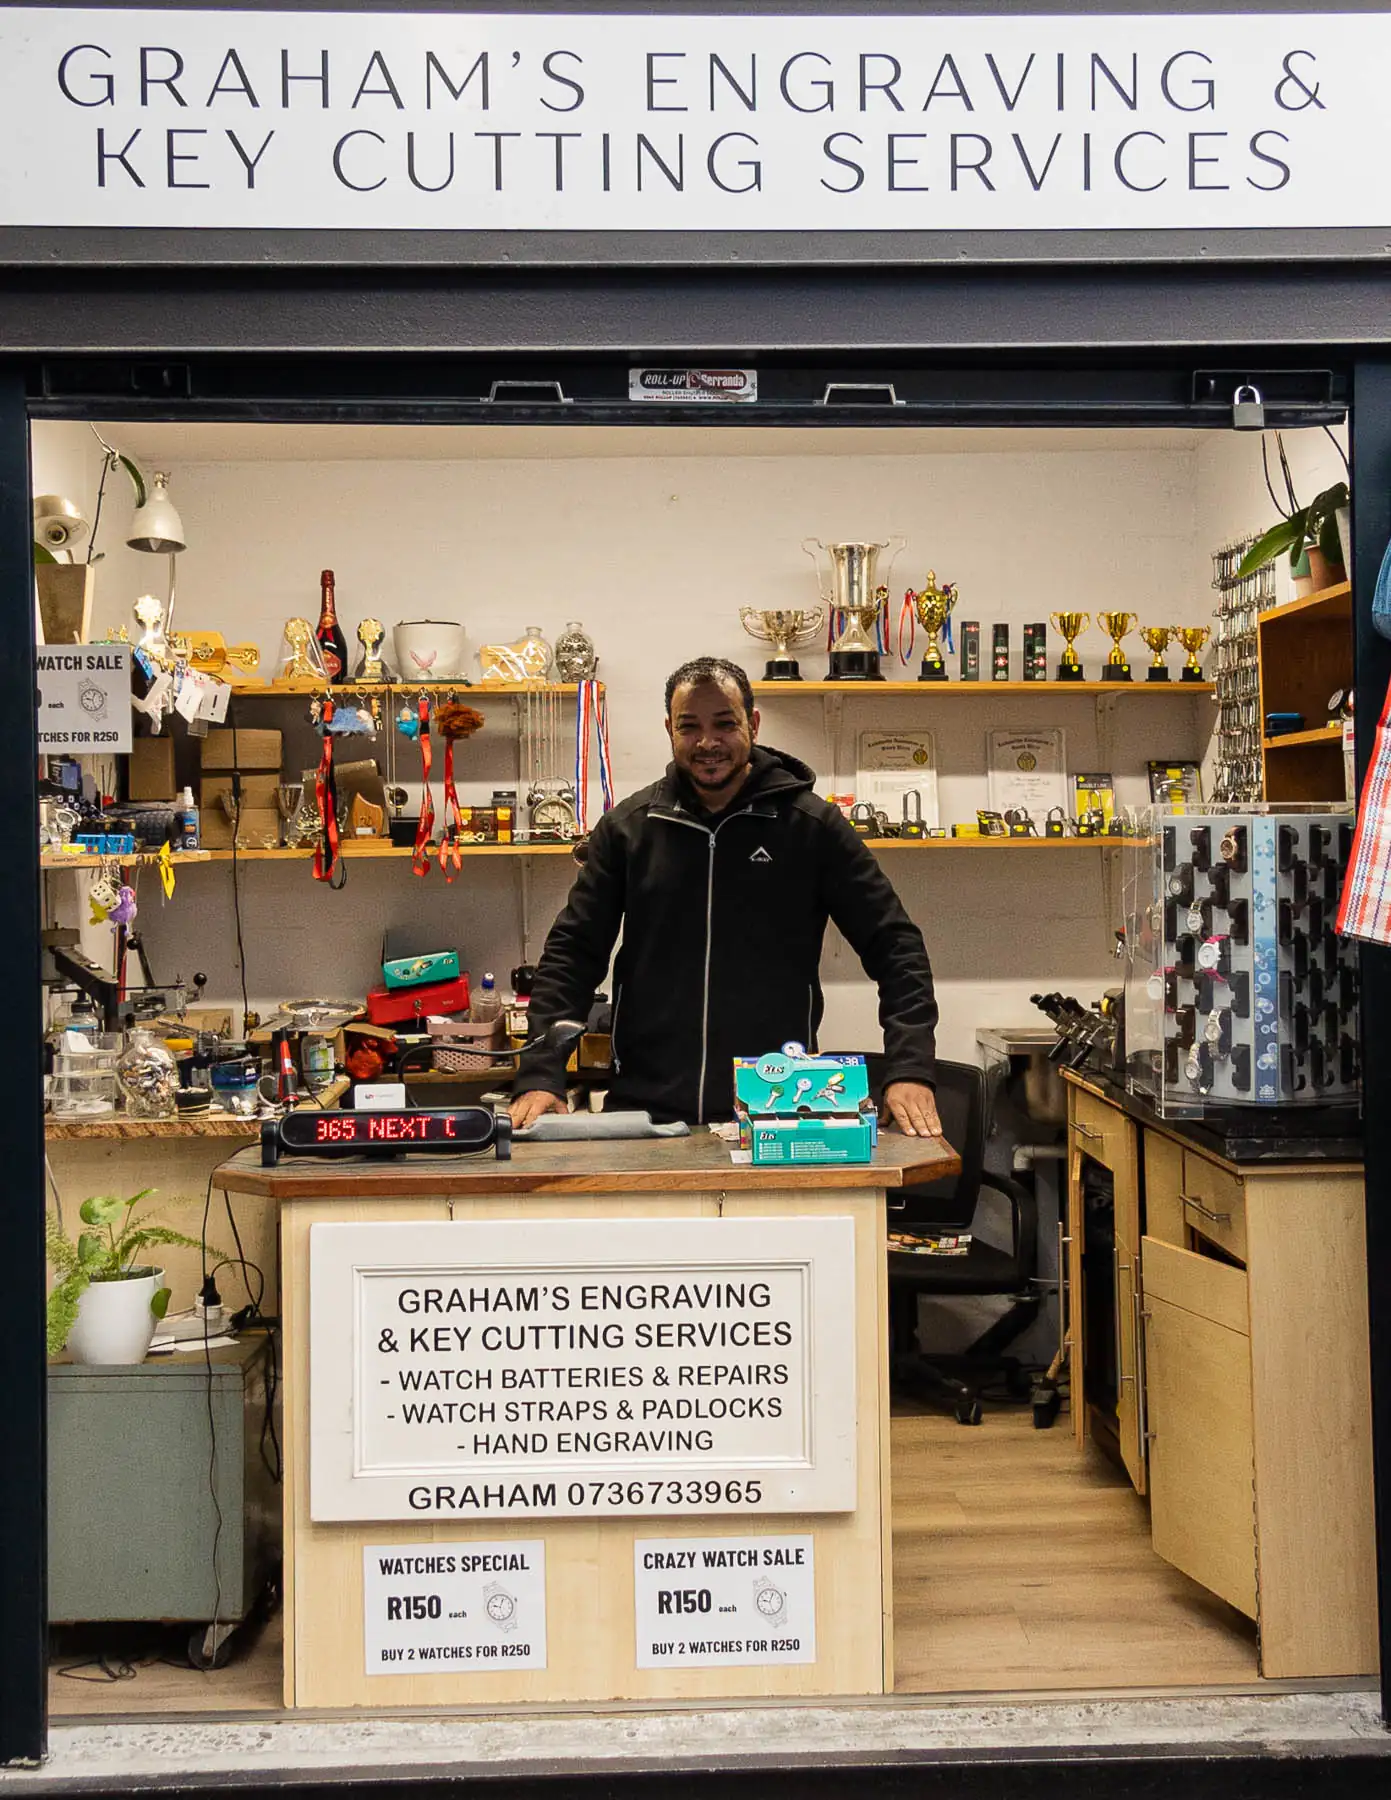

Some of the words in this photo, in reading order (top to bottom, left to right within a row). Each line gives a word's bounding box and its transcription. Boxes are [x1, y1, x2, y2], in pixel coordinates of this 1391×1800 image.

[58, 45, 585, 111] GRAHAM'S
[647, 51, 1215, 112] ENGRAVING
[1275, 51, 1326, 110] &
[97, 128, 275, 189] KEY
[333, 130, 762, 193] CUTTING
[820, 131, 1291, 192] SERVICES
[644, 374, 686, 385] ROLL-UP
[701, 374, 744, 387] Serranda
[36, 656, 82, 670] WATCH
[86, 655, 123, 670] SALE
[38, 732, 69, 743] TCHES
[72, 732, 90, 743] FOR
[94, 731, 119, 742] R250
[369, 1117, 431, 1139] NEXT
[398, 1286, 570, 1314] GRAHAM'S
[582, 1284, 771, 1310] ENGRAVING
[378, 1328, 400, 1353] &
[411, 1326, 472, 1352] KEY
[481, 1325, 624, 1351] CUTTING
[635, 1322, 792, 1348] SERVICES
[399, 1369, 492, 1391] WATCH
[501, 1367, 644, 1389] BATTERIES
[652, 1366, 670, 1387] &
[678, 1365, 789, 1387] REPAIRS
[402, 1403, 496, 1424] WATCH
[505, 1401, 608, 1423] STRAPS
[616, 1399, 634, 1420] &
[642, 1398, 782, 1420] PADLOCKS
[473, 1434, 548, 1454] HAND
[557, 1431, 713, 1453] ENGRAVING
[408, 1484, 556, 1510] GRAHAM
[567, 1481, 762, 1506] 0736733965
[379, 1556, 456, 1575] WATCHES
[461, 1554, 530, 1573] SPECIAL
[643, 1551, 697, 1570] CRAZY
[703, 1550, 758, 1568] WATCH
[763, 1548, 805, 1566] SALE
[387, 1595, 442, 1621] R150
[449, 1611, 467, 1619] each
[658, 1588, 712, 1615] R150
[718, 1605, 737, 1613] each
[381, 1648, 404, 1661] BUY
[407, 1648, 415, 1660] 2
[419, 1646, 473, 1660] WATCHES
[477, 1645, 498, 1658] FOR
[501, 1644, 531, 1657] R250
[652, 1642, 675, 1655] BUY
[678, 1642, 686, 1655] 2
[689, 1641, 743, 1654] WATCHES
[746, 1640, 768, 1653] FOR
[771, 1638, 800, 1652] R250
